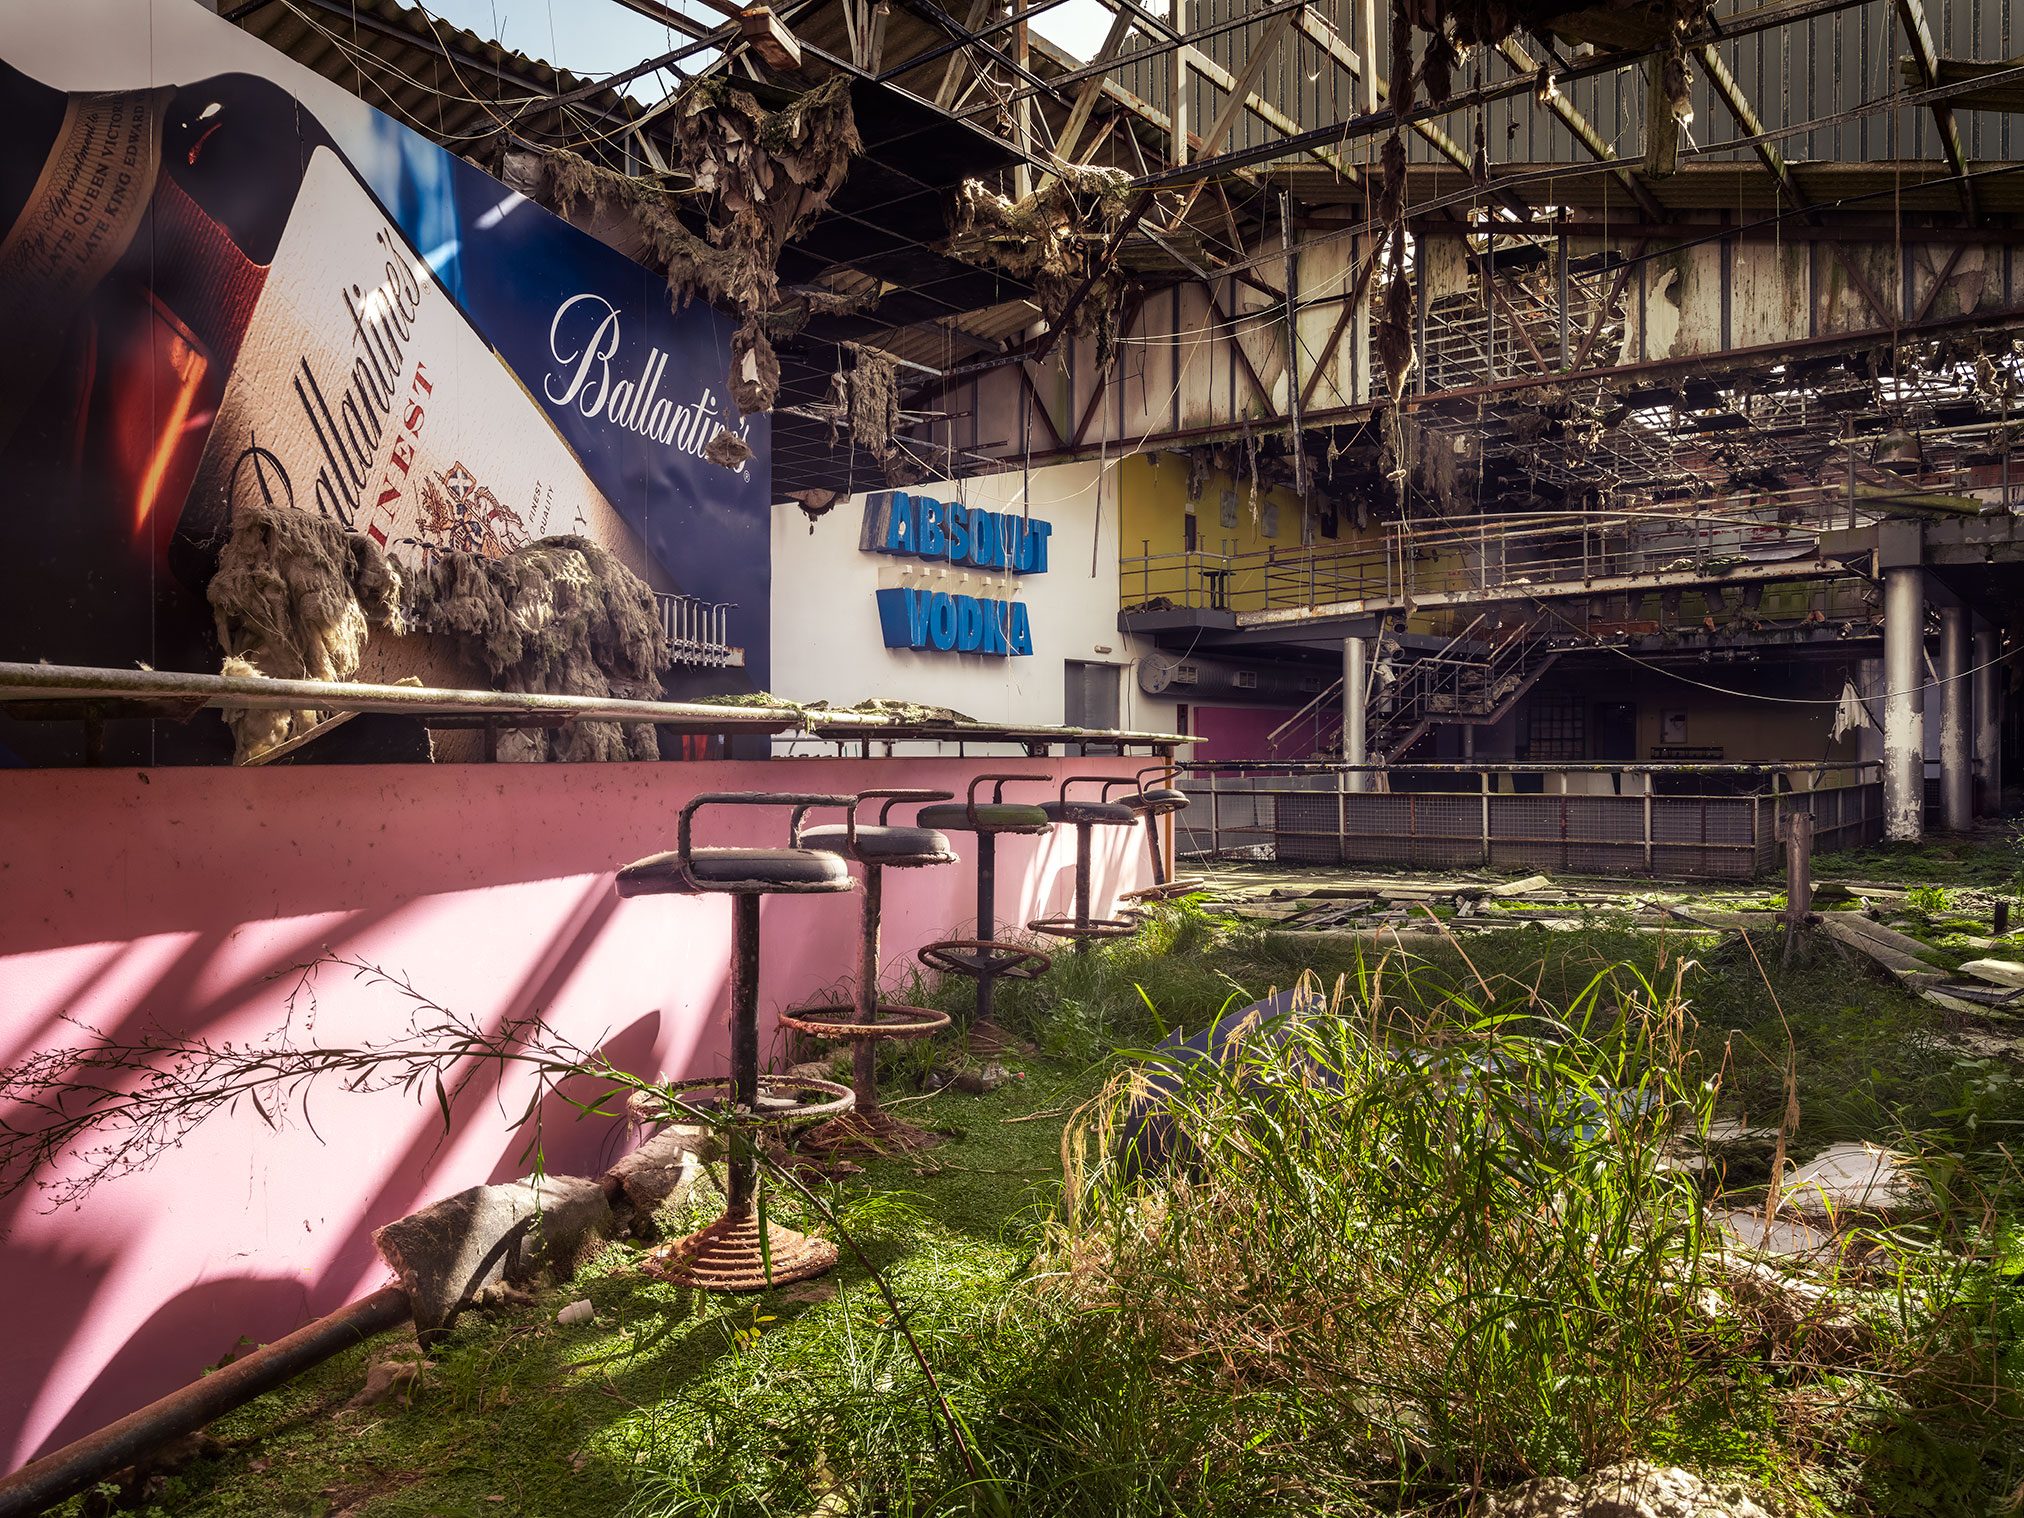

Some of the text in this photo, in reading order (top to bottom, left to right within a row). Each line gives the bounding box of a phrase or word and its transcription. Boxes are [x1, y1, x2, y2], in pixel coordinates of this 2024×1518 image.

[38, 97, 124, 277] LATE QUEEN VICTORI
[76, 222, 109, 264] LATE
[104, 172, 131, 217] KING
[123, 105, 145, 168] EDWARD
[544, 294, 750, 473] Ballanti's
[367, 361, 434, 552] INEST
[528, 480, 542, 523] FINEST
[540, 485, 554, 534] QUALITY
[876, 491, 1052, 575] ABSOLUT
[884, 587, 1034, 656] VODKA
